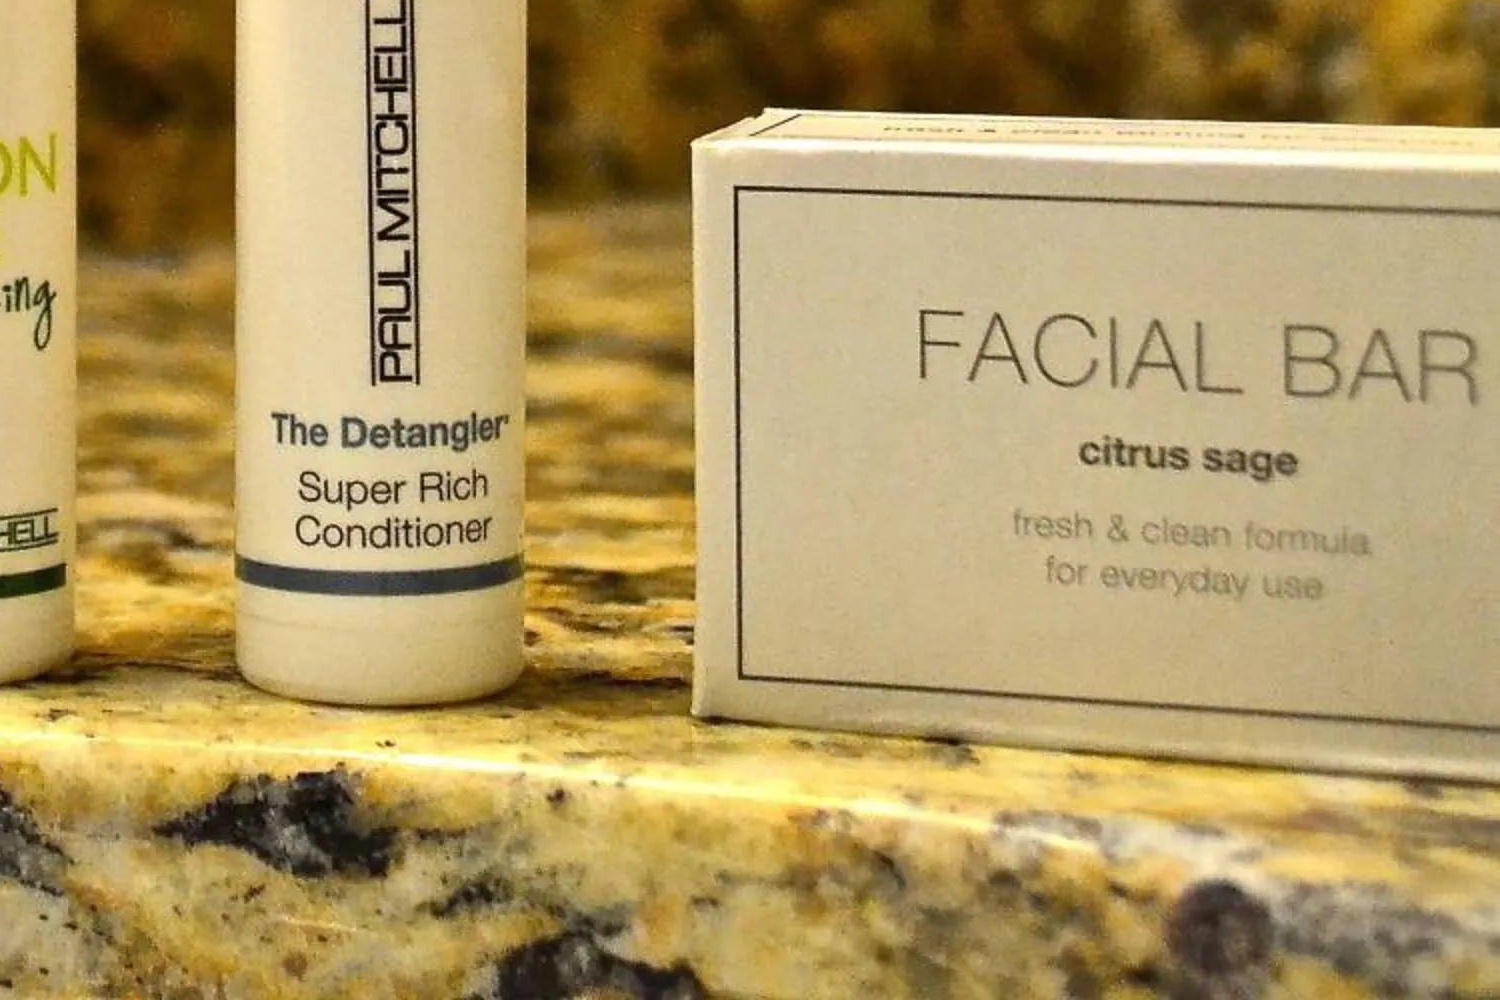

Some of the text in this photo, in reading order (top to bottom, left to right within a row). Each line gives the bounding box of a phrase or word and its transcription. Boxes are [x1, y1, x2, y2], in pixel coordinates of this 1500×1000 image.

[378, 250, 413, 384] PAUL
[917, 308, 1481, 407] FACIAL BAR
[270, 411, 503, 453] The Detangler
[1077, 434, 1299, 484] citrus sage
[298, 469, 489, 512] Super Rich
[295, 514, 493, 550] Conditioner
[1012, 508, 1374, 560] fresh & clean formula
[1043, 554, 1326, 603] for everyday use
